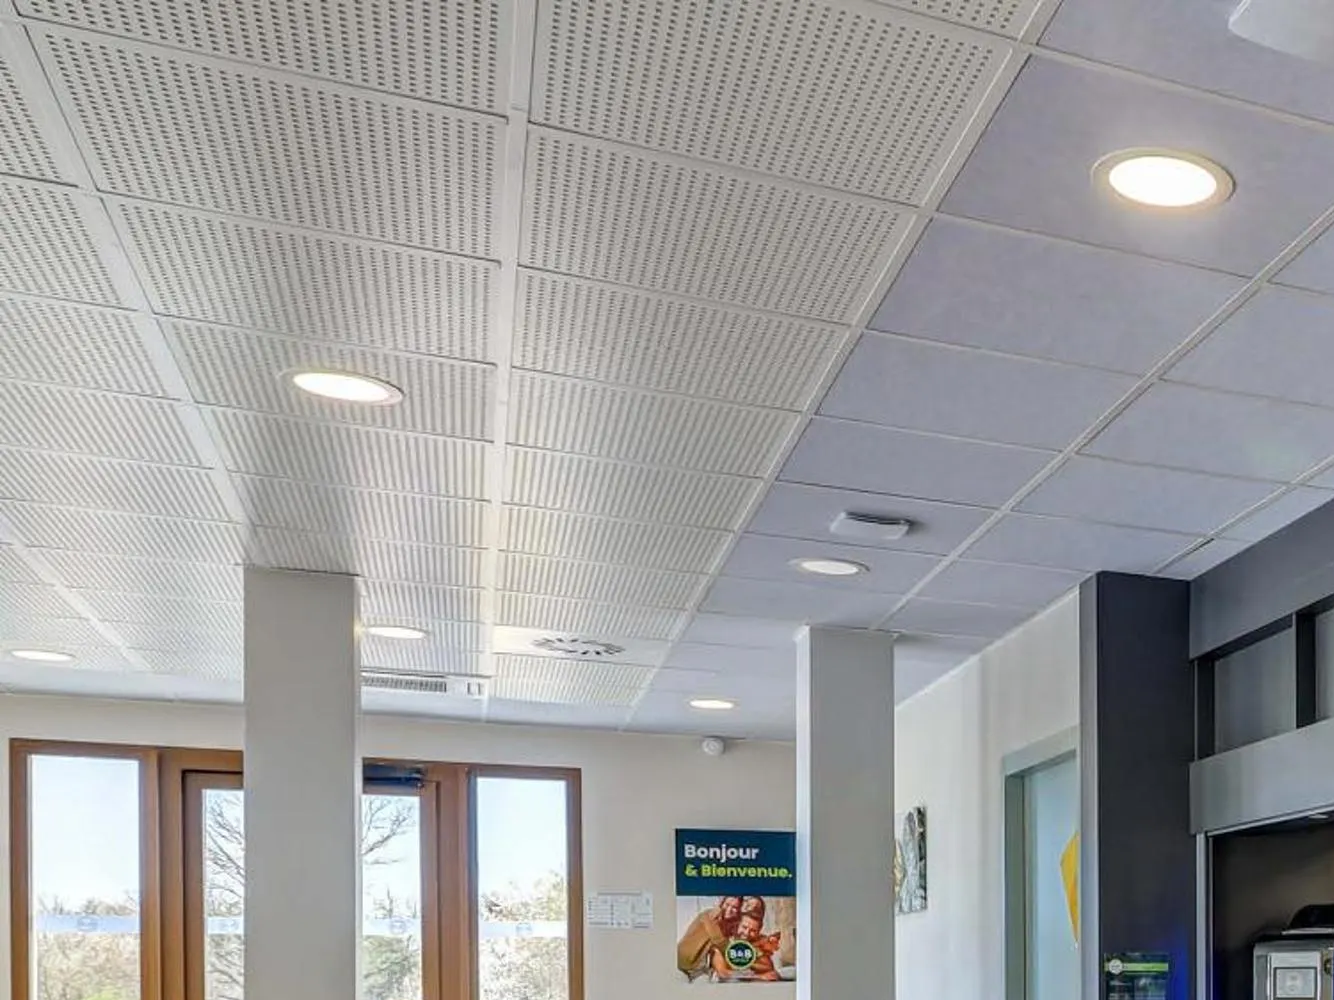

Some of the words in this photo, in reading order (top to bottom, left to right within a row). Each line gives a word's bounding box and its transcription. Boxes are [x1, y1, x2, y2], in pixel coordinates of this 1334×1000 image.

[684, 843, 759, 862] Bonjour
[685, 864, 697, 876] &
[701, 863, 792, 877] Bienvenue.
